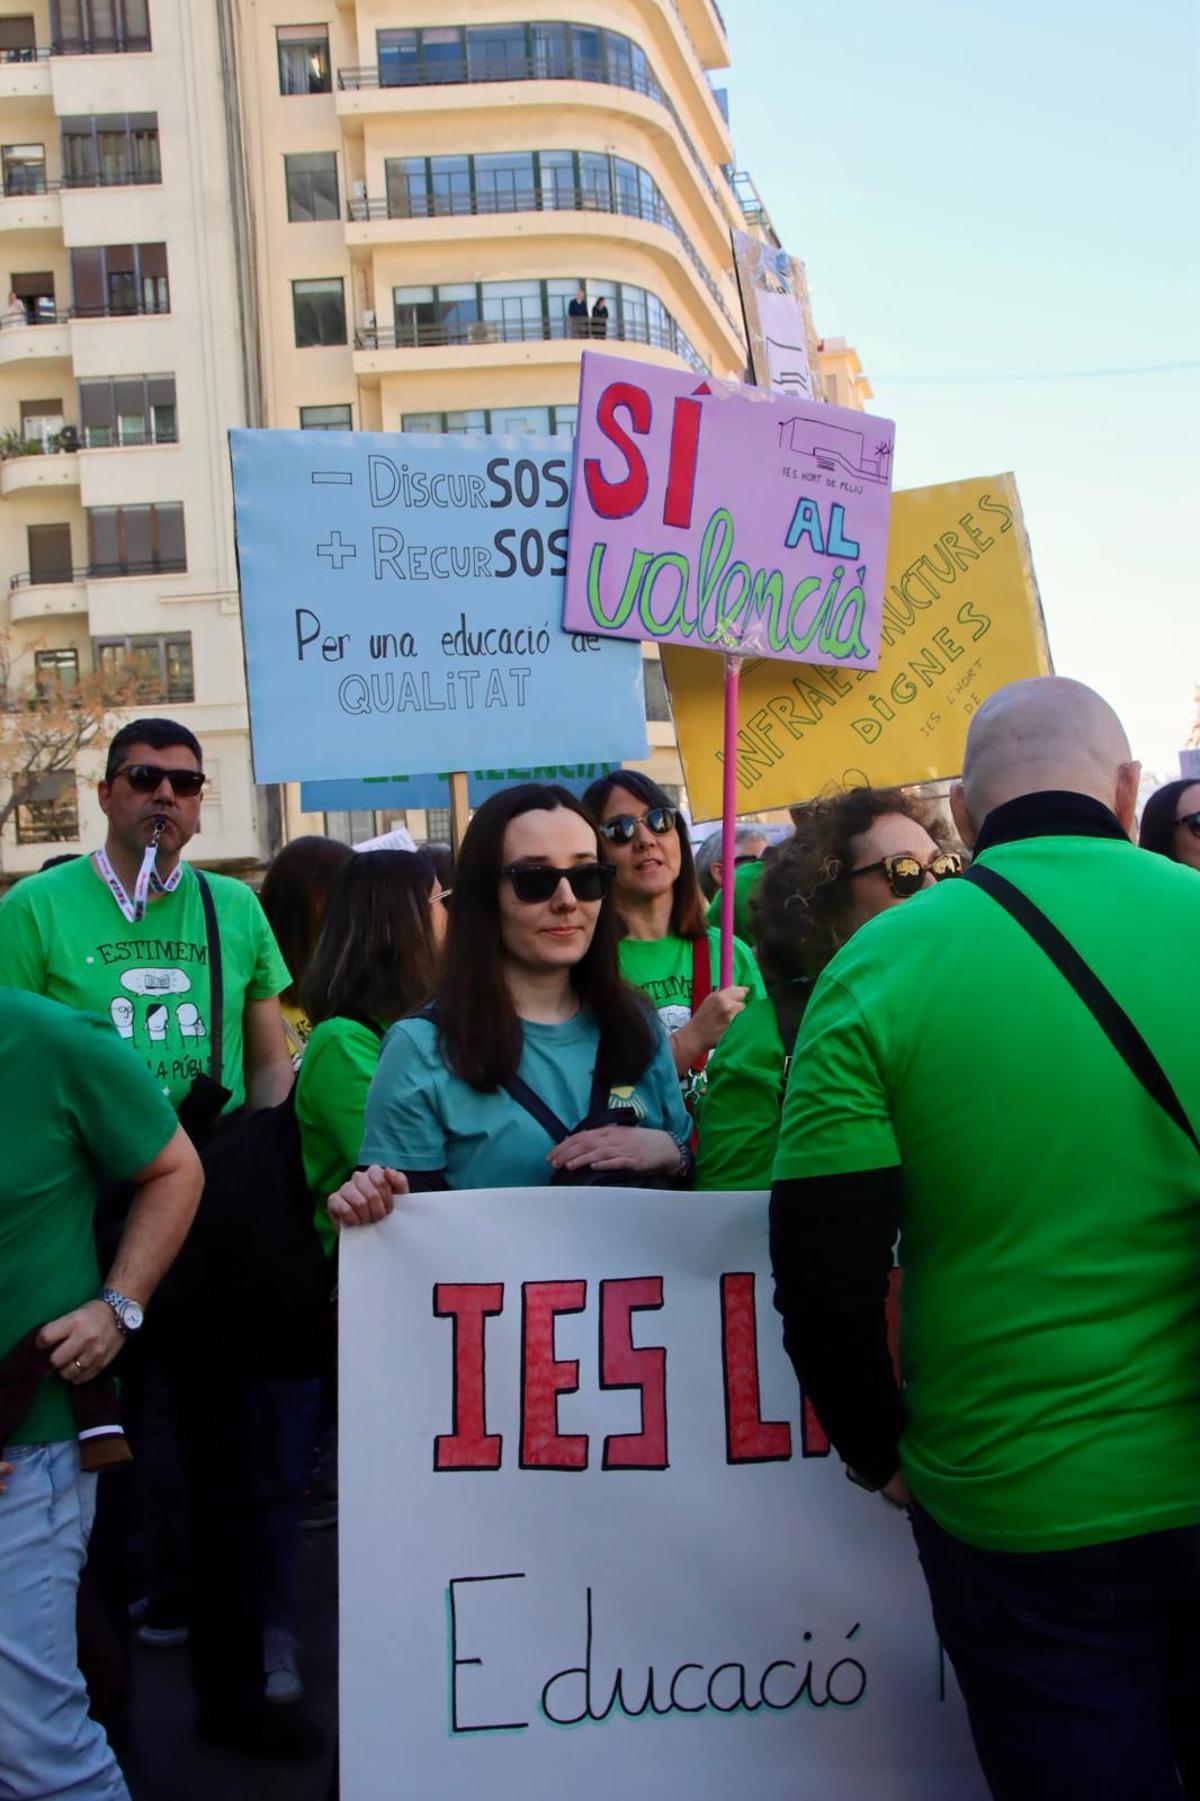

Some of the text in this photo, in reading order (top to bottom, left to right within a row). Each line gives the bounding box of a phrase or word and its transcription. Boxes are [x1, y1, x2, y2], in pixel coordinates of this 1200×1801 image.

[583, 380, 712, 529] SÍ
[783, 466, 798, 479] IES
[801, 472, 821, 482] HORT
[826, 479, 836, 488] DE
[371, 526, 568, 580] RECURSOS
[784, 496, 860, 561] AL
[295, 608, 350, 661] Per
[369, 629, 418, 659] una
[441, 613, 550, 657] educació
[920, 711, 942, 737] IES
[96, 939, 207, 965] ESTIMEM
[433, 1275, 670, 1471] IES
[446, 1573, 867, 1737] Educació
